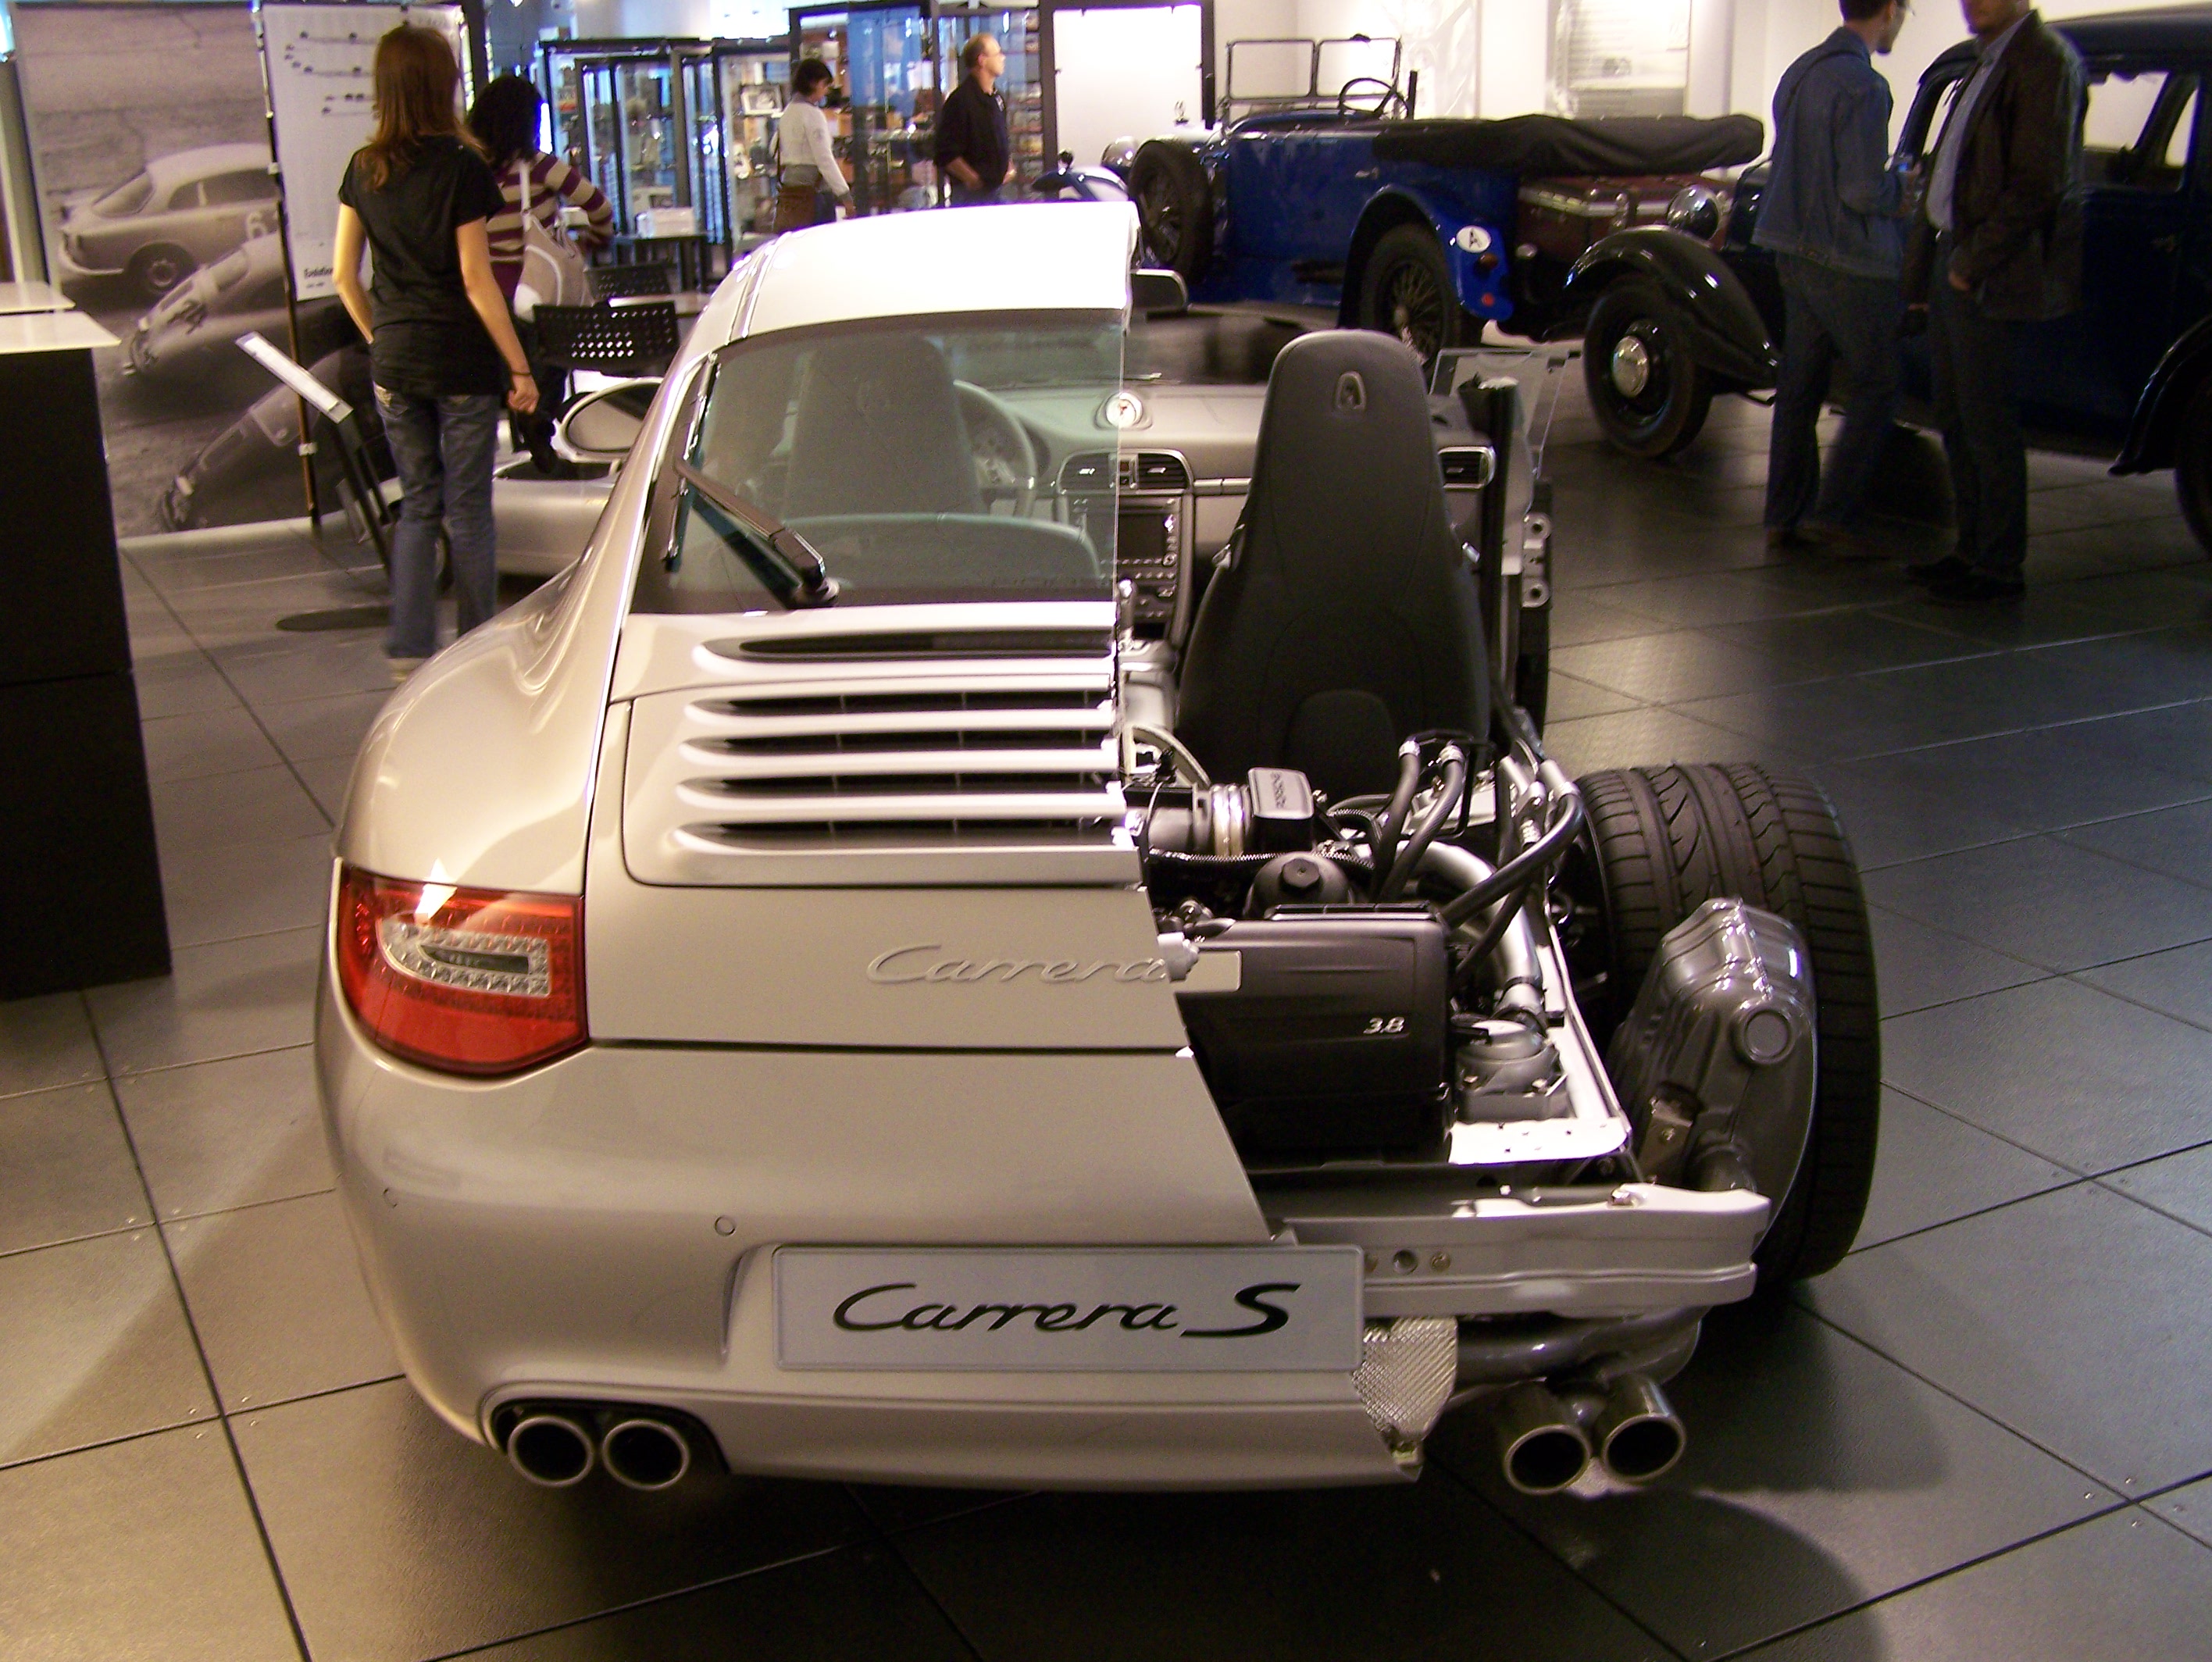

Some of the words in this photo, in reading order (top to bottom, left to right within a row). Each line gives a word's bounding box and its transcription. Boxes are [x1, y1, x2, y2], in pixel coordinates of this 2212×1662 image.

[866, 943, 1167, 983] Carrera
[1363, 1016, 1405, 1034] 3.8
[833, 1282, 1178, 1331] Carrera
[1179, 1282, 1301, 1339] S
